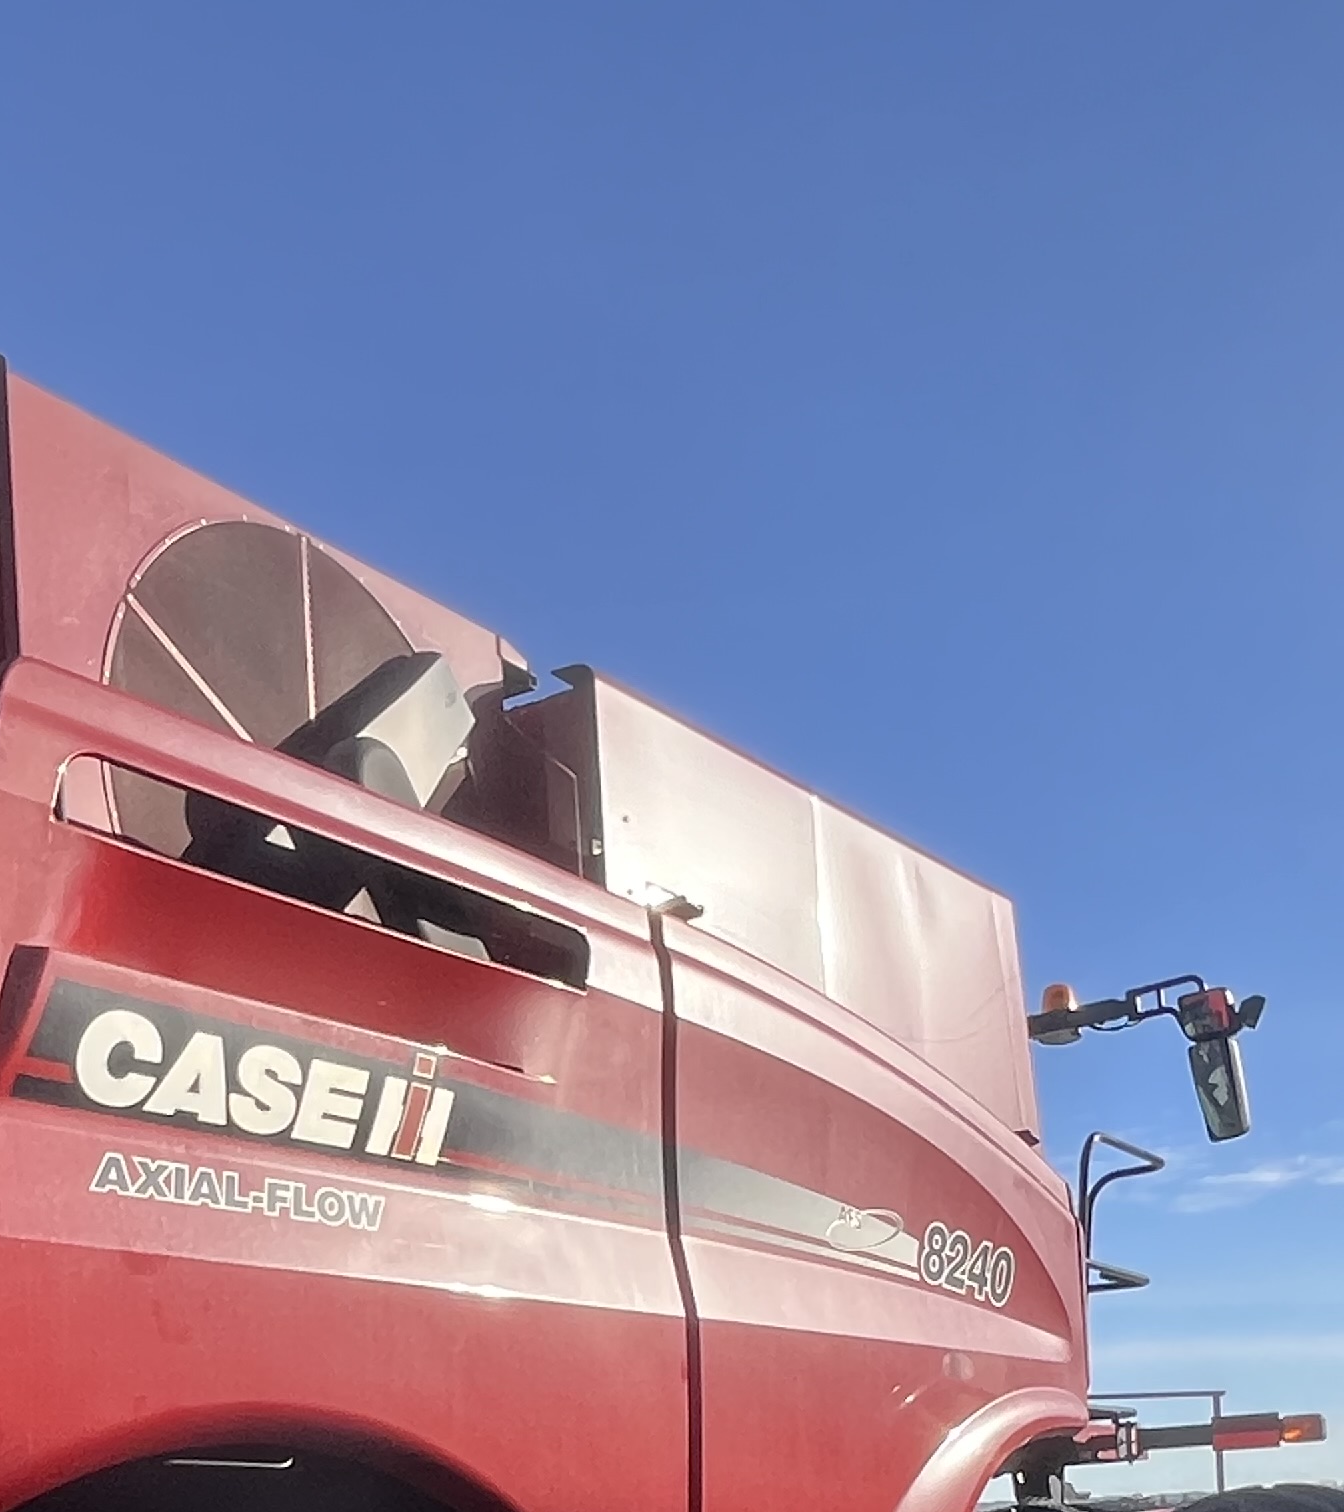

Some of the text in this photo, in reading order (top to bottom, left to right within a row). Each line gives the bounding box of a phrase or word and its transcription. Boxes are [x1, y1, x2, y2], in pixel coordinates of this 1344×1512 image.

[76, 1009, 370, 1150] CASE
[89, 1152, 385, 1231] AXIAL-FLOW
[920, 1221, 1015, 1308] 8240
